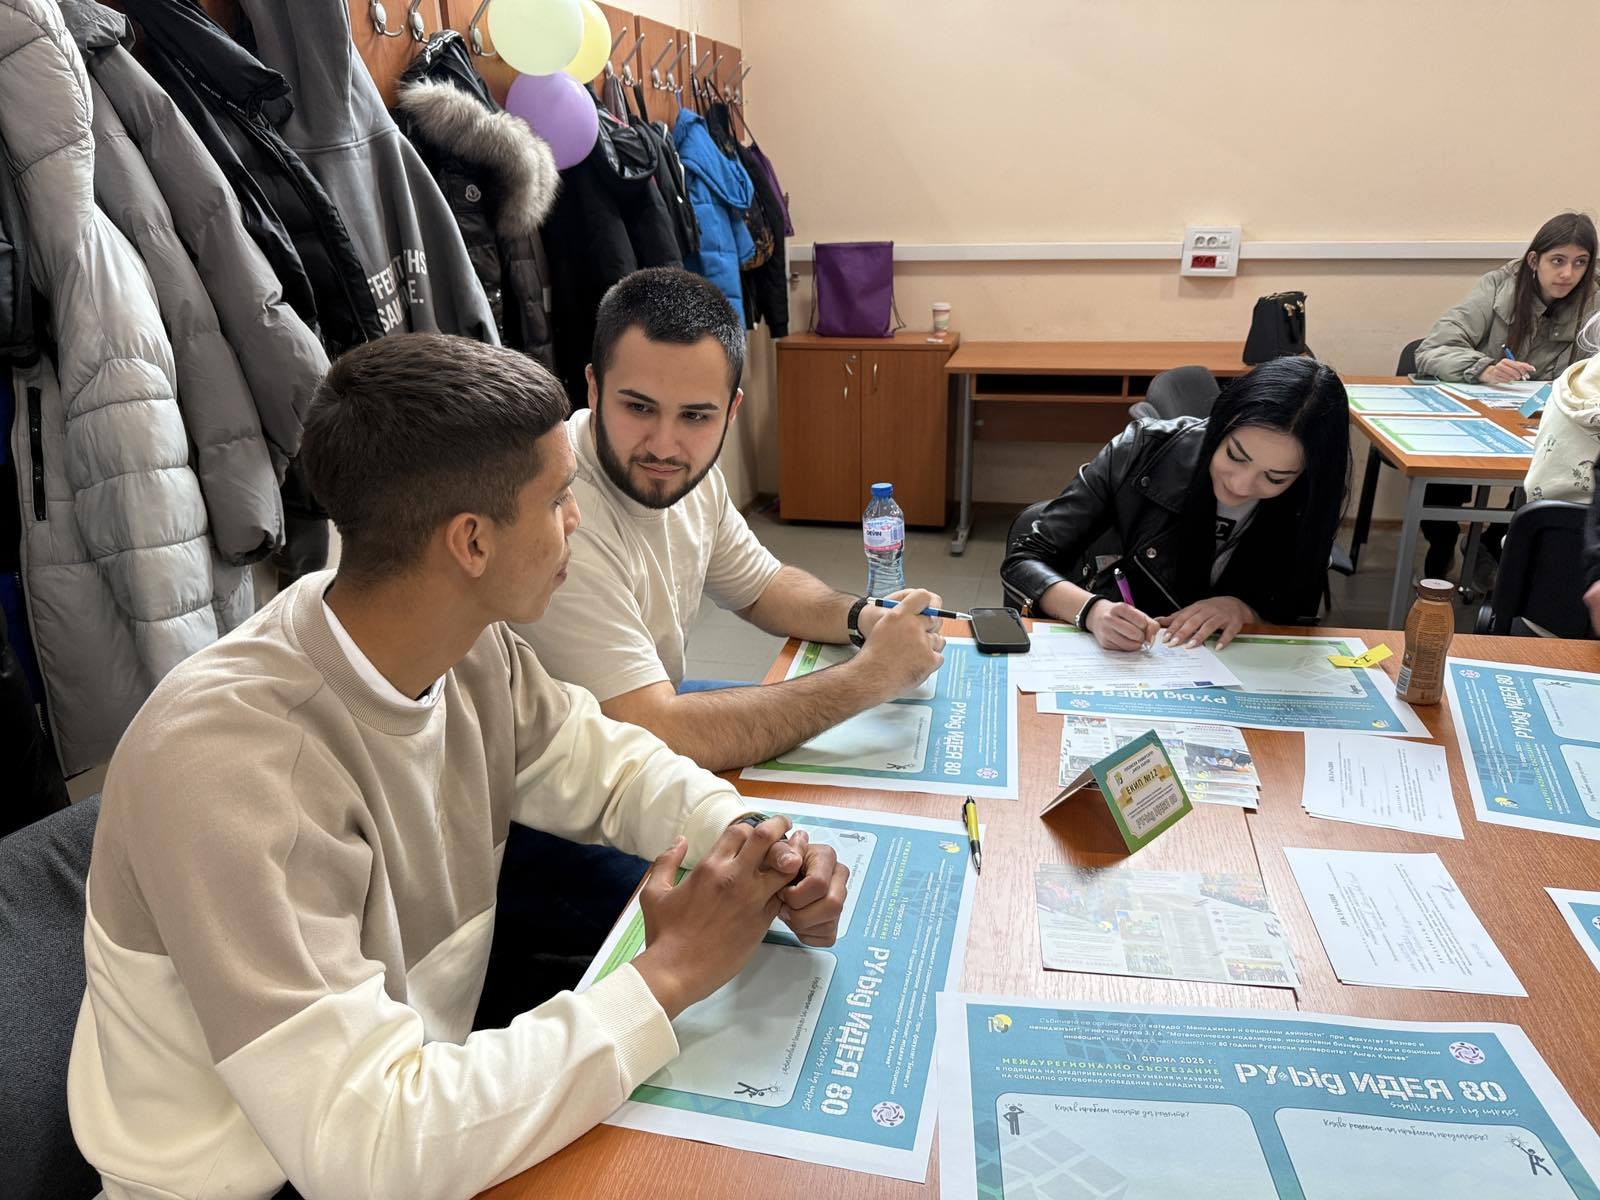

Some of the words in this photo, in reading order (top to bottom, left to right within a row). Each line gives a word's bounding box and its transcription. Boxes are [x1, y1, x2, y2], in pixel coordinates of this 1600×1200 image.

[944, 762, 961, 775] 80
[1126, 779, 1144, 795] ЕКИП
[831, 1011, 873, 1078] ИДЕЯ
[1141, 1055, 1177, 1063] април
[1179, 1056, 1204, 1064] 2025
[1350, 1072, 1454, 1101] ИДЕЯ
[1458, 1080, 1508, 1102] 80
[820, 1083, 853, 1116] 80
